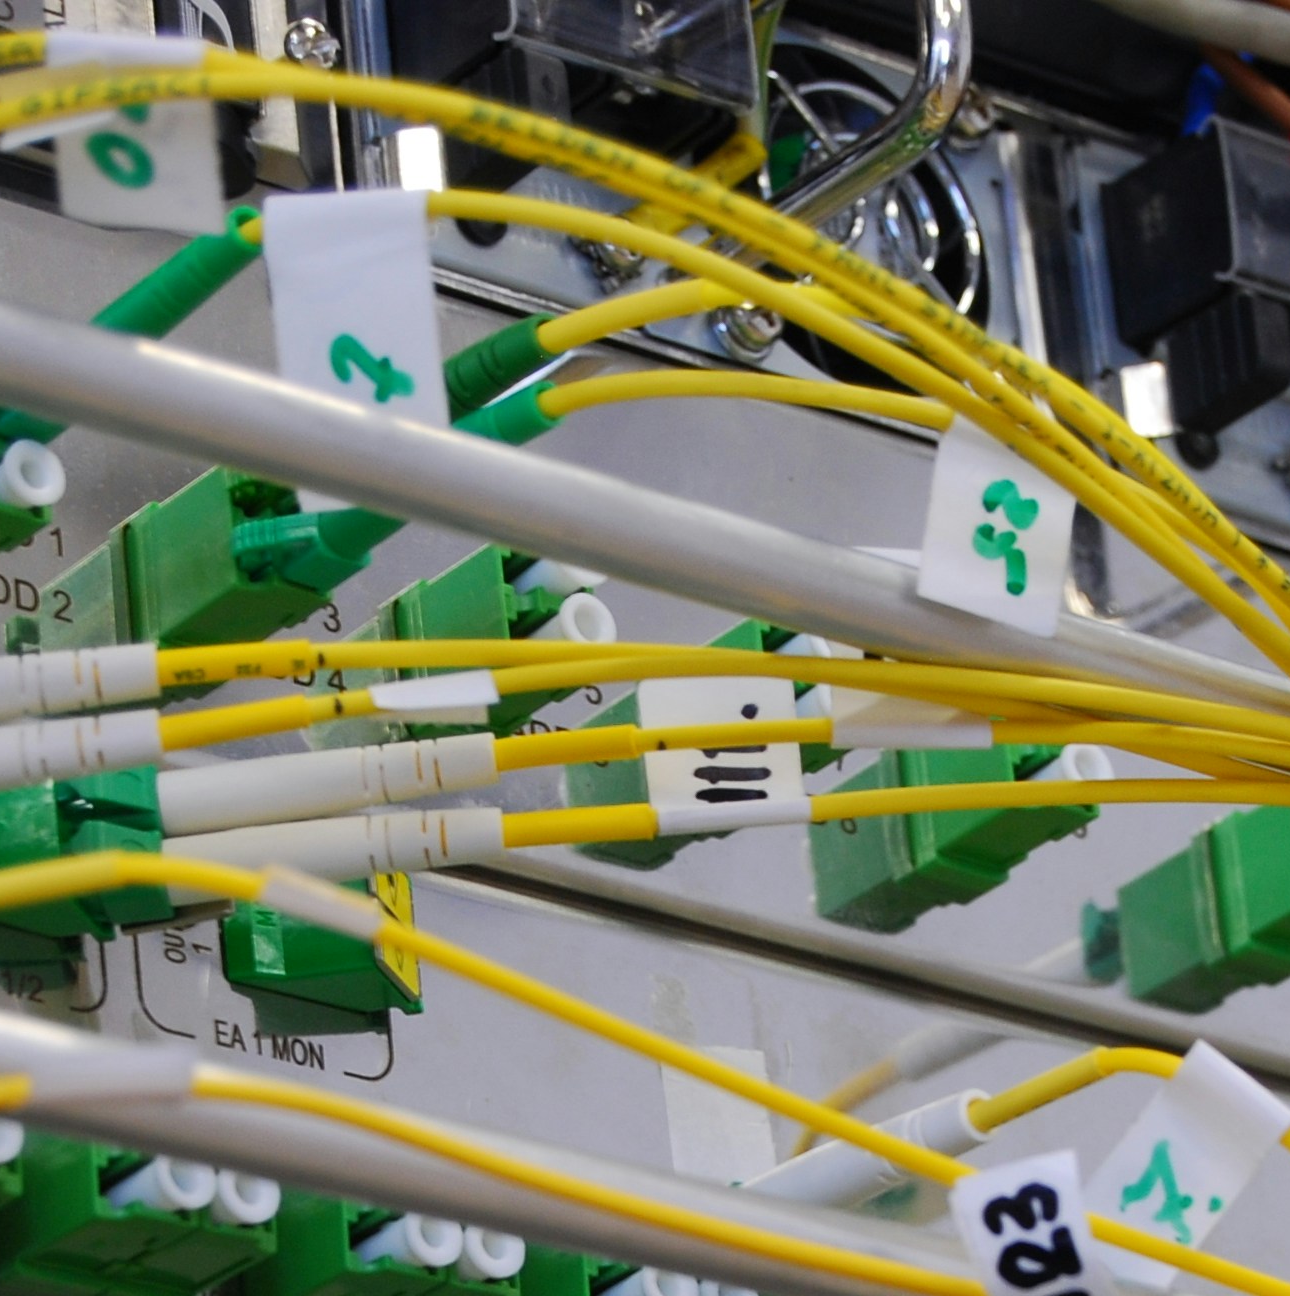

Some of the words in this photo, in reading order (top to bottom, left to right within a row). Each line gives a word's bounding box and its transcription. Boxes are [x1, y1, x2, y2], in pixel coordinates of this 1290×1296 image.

[52, 590, 74, 623] 2
[323, 602, 342, 633] 3
[214, 1019, 247, 1053] EA
[253, 1031, 265, 1056] 1
[271, 1034, 326, 1071] MON
